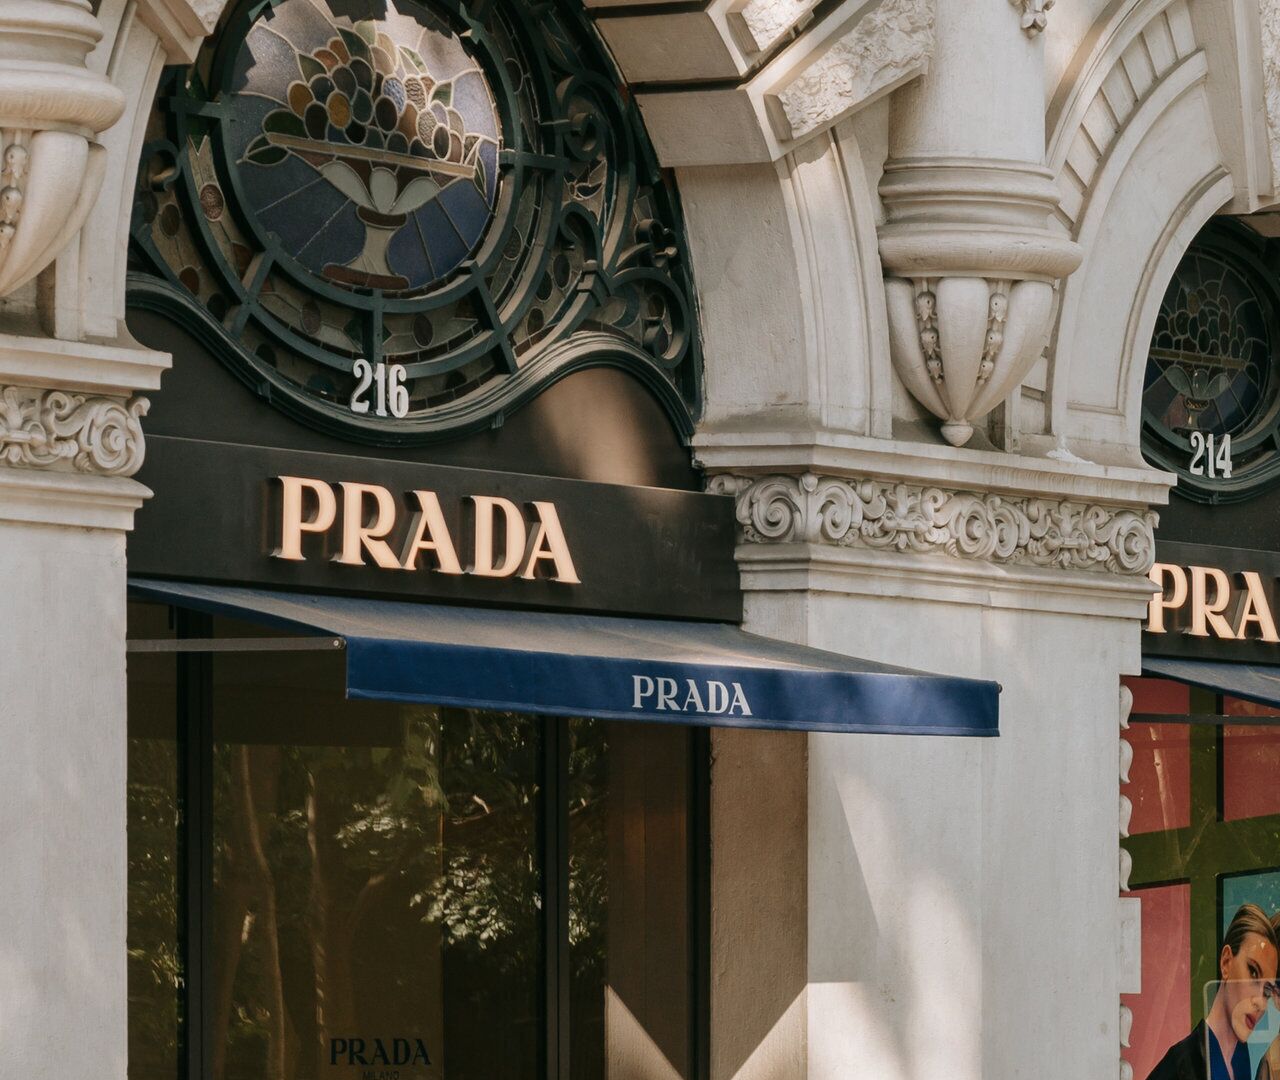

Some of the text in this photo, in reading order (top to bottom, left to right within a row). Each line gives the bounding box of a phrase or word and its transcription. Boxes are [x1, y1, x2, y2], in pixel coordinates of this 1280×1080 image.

[351, 358, 409, 419] 216
[1189, 431, 1233, 479] 214
[276, 475, 582, 584] PRADA
[632, 674, 754, 718] PRADA
[329, 1038, 432, 1065] PRADA
[362, 1070, 400, 1080] MILANO
